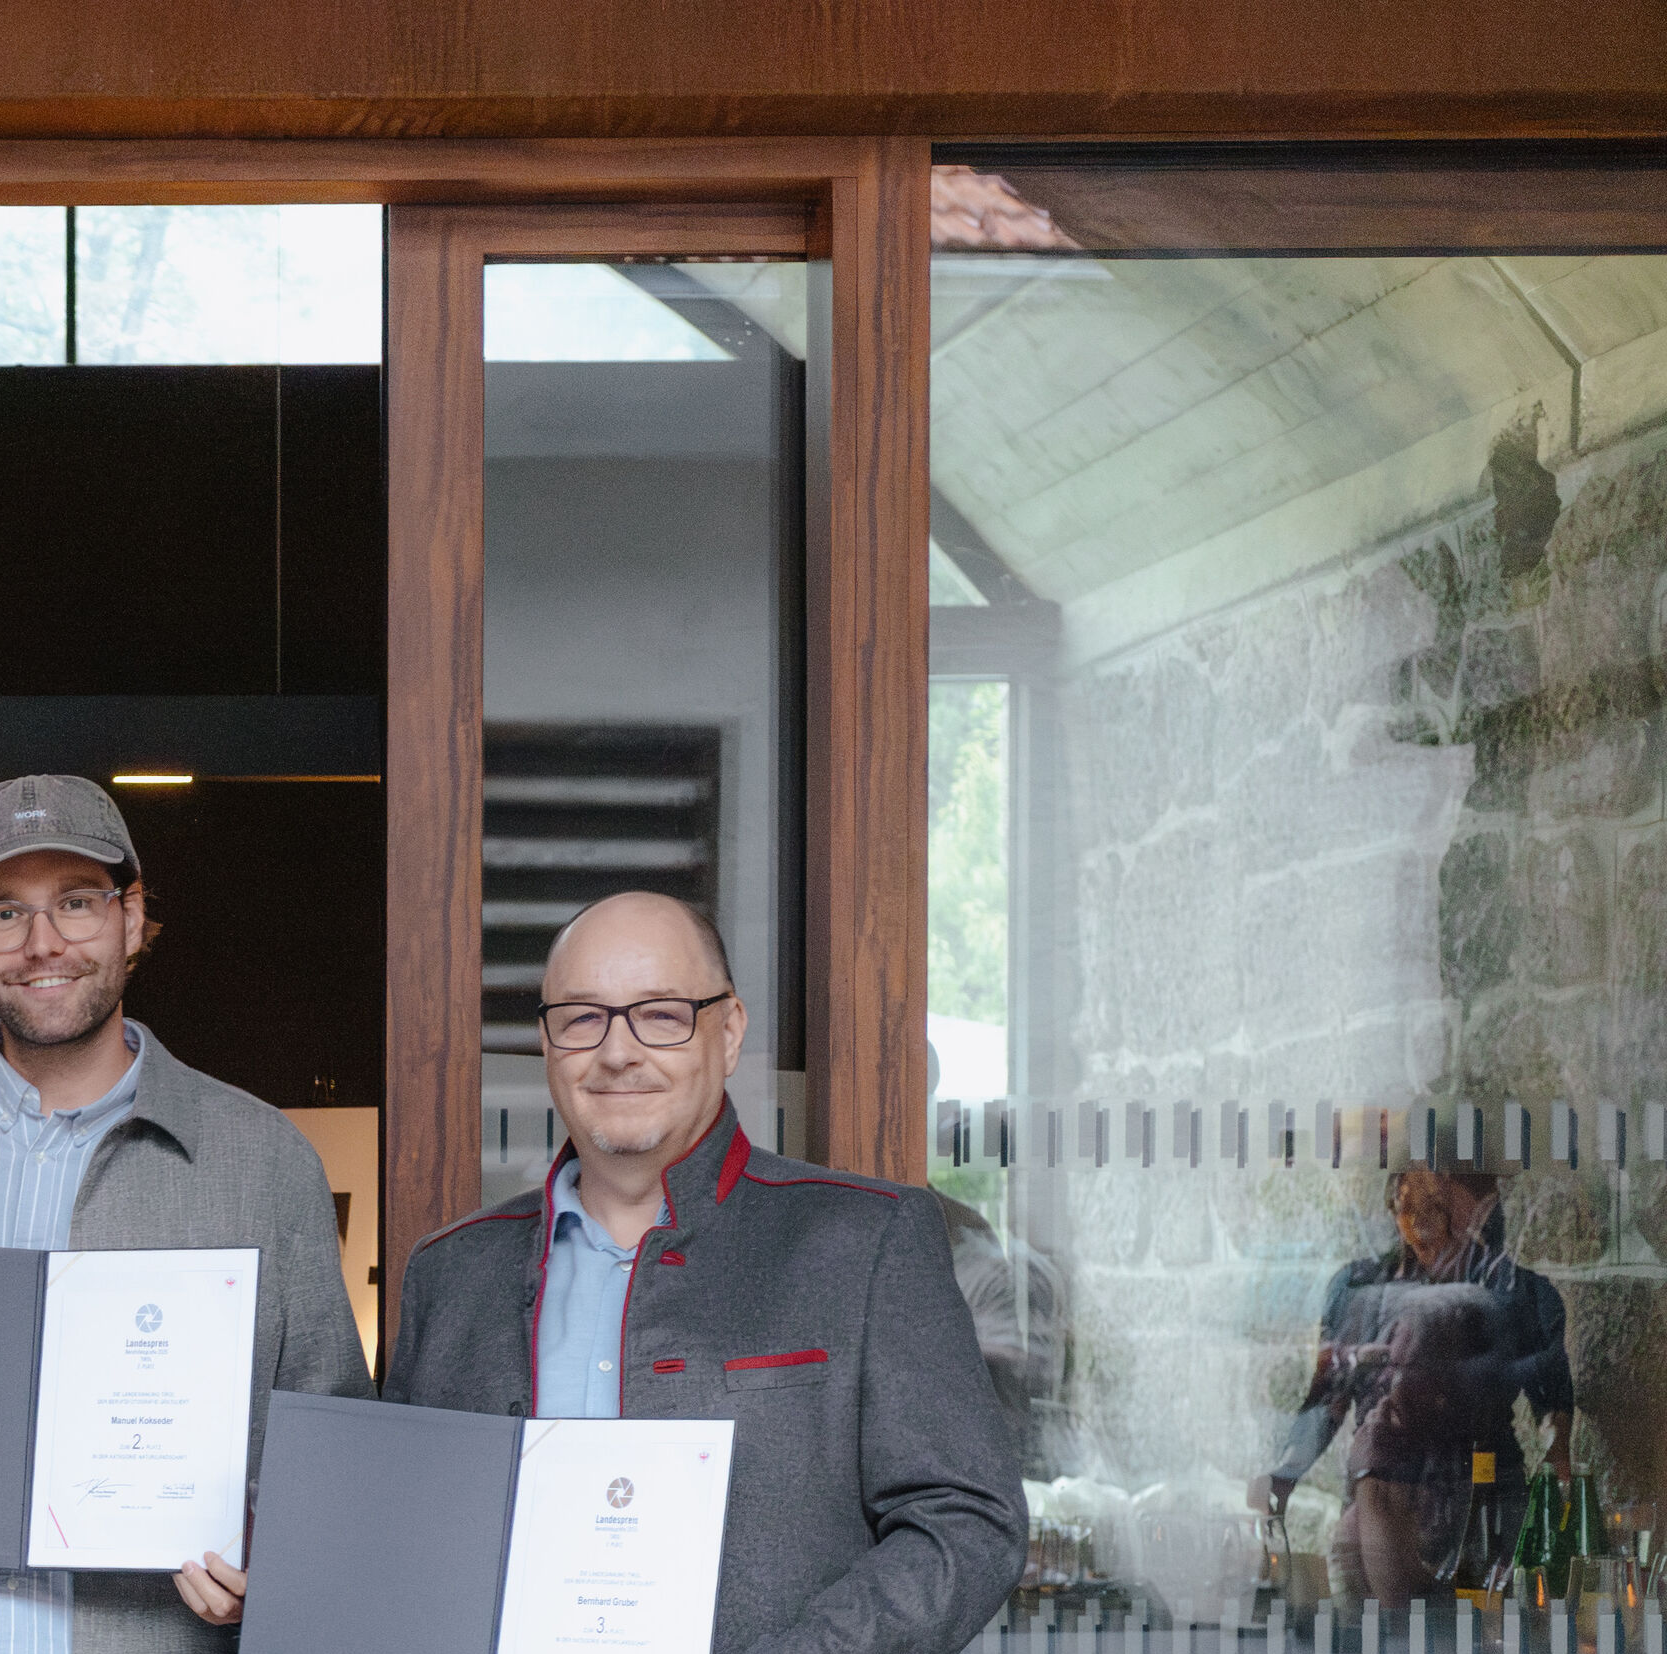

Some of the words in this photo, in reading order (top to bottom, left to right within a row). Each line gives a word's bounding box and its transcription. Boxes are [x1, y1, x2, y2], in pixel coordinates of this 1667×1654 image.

[126, 1339, 169, 1349] Landespreis
[111, 1416, 137, 1425] Manuel
[139, 1416, 174, 1425] Kokseder
